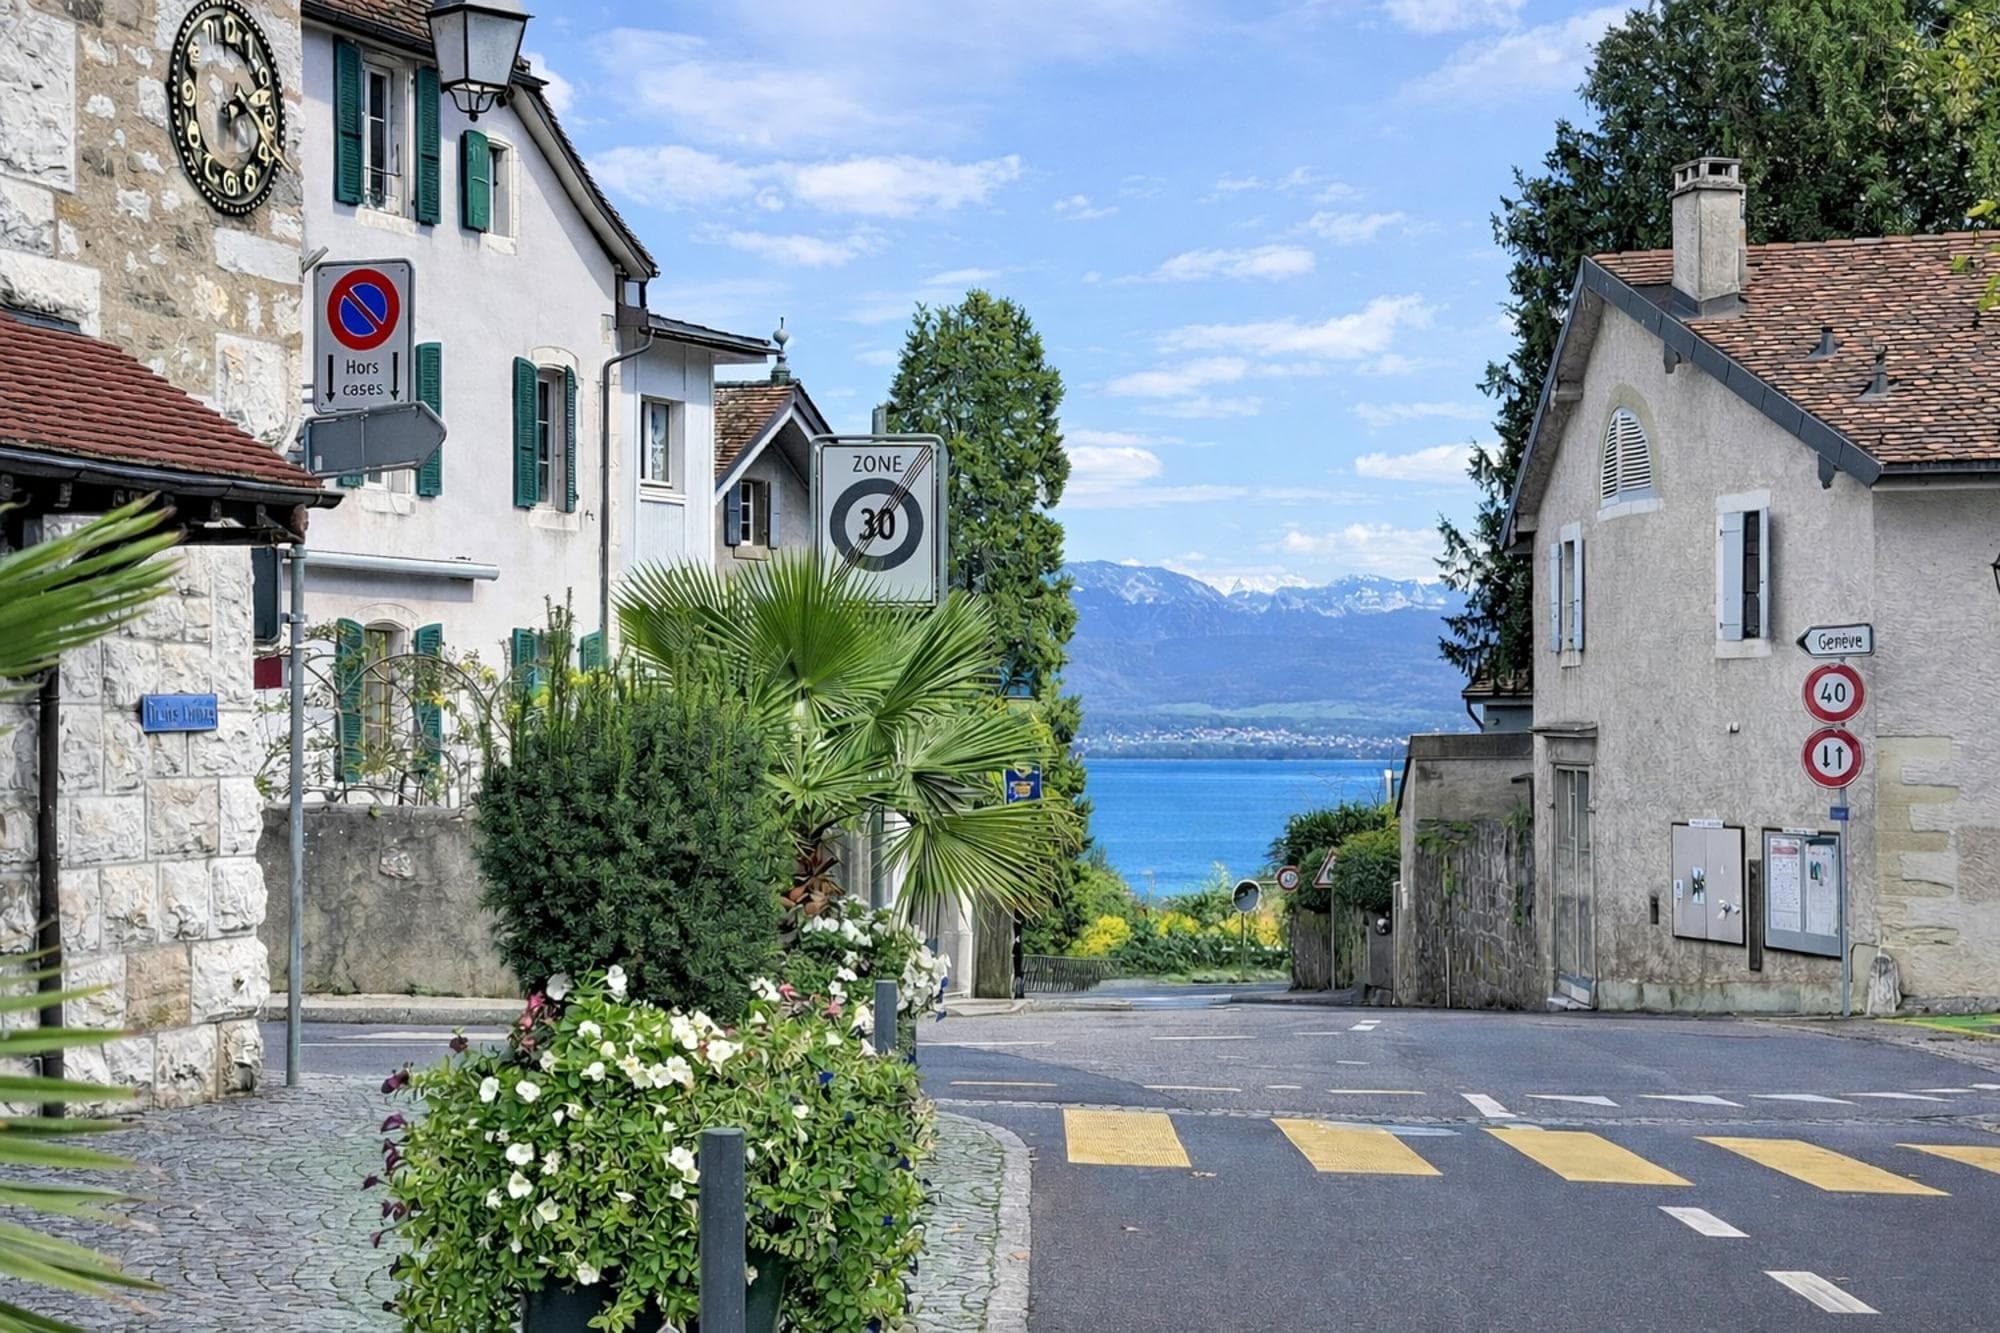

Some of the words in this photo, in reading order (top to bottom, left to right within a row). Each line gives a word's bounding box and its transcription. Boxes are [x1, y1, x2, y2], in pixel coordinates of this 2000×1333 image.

[346, 359, 379, 375] Hors
[342, 383, 384, 396] cases
[852, 455, 904, 473] ZONE
[859, 508, 896, 540] 30
[1818, 632, 1863, 651] Genève
[1821, 682, 1846, 704] 40
